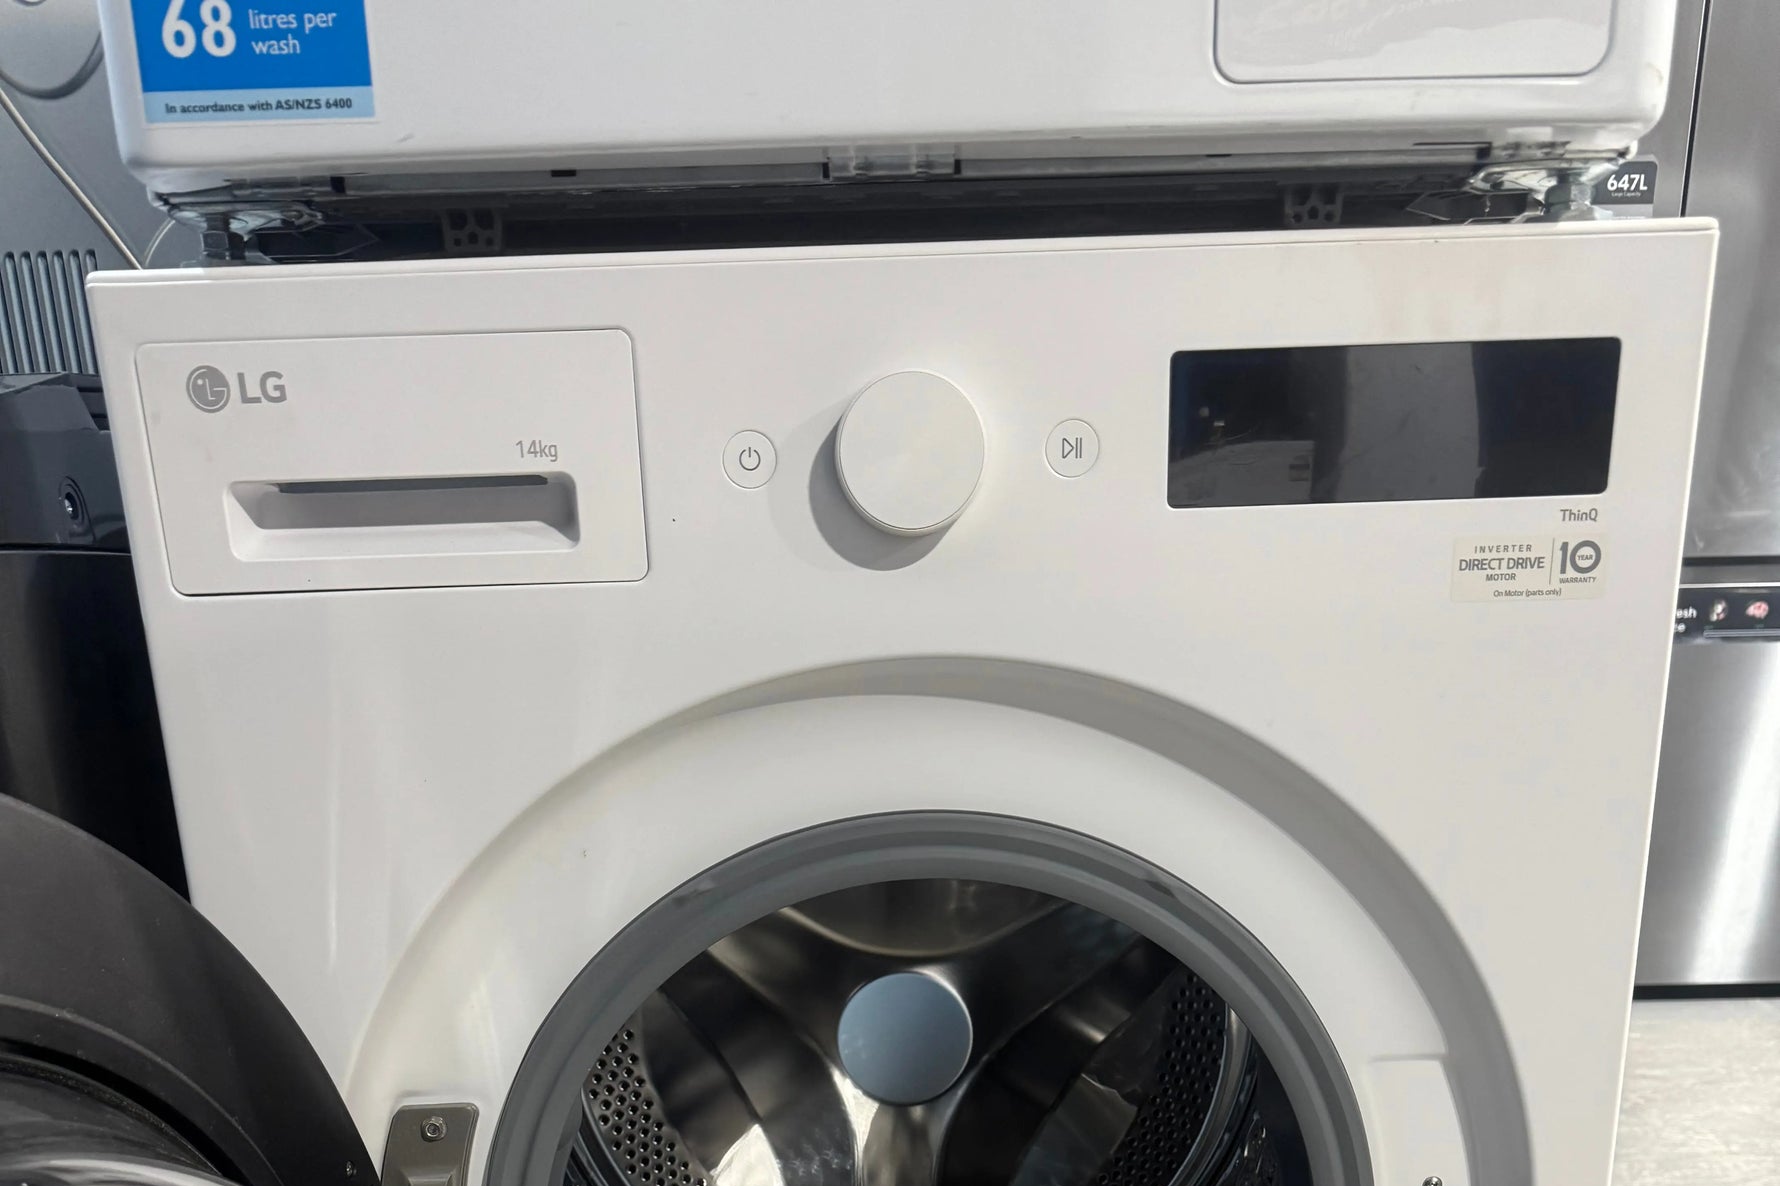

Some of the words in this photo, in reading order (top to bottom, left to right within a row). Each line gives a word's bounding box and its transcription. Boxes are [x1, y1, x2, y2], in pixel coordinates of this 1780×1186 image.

[162, 0, 237, 58] 68
[249, 9, 298, 30] litres
[304, 11, 337, 34] per
[251, 34, 301, 55] wash
[165, 103, 177, 114] In
[180, 101, 245, 114] accordance
[249, 100, 273, 112] with
[275, 98, 322, 111] AS/NZS
[324, 97, 353, 110] 6400
[1607, 174, 1648, 191] 647L
[237, 370, 288, 404] LG
[515, 440, 558, 463] 14kg
[1560, 508, 1599, 523] ThinQ
[1474, 544, 1533, 555] INVERTER
[1559, 540, 1602, 575] 10
[1459, 558, 1505, 572] DIRECT
[1506, 556, 1546, 570] DRIVE
[1576, 554, 1594, 562] YEAR
[1485, 573, 1517, 582] MOTOR
[1559, 576, 1597, 585] WARRANTY
[1493, 590, 1504, 598] On
[1504, 588, 1525, 598] Motor
[1525, 588, 1545, 598] (parts
[1545, 587, 1562, 597] only)
[1675, 606, 1696, 619] esh
